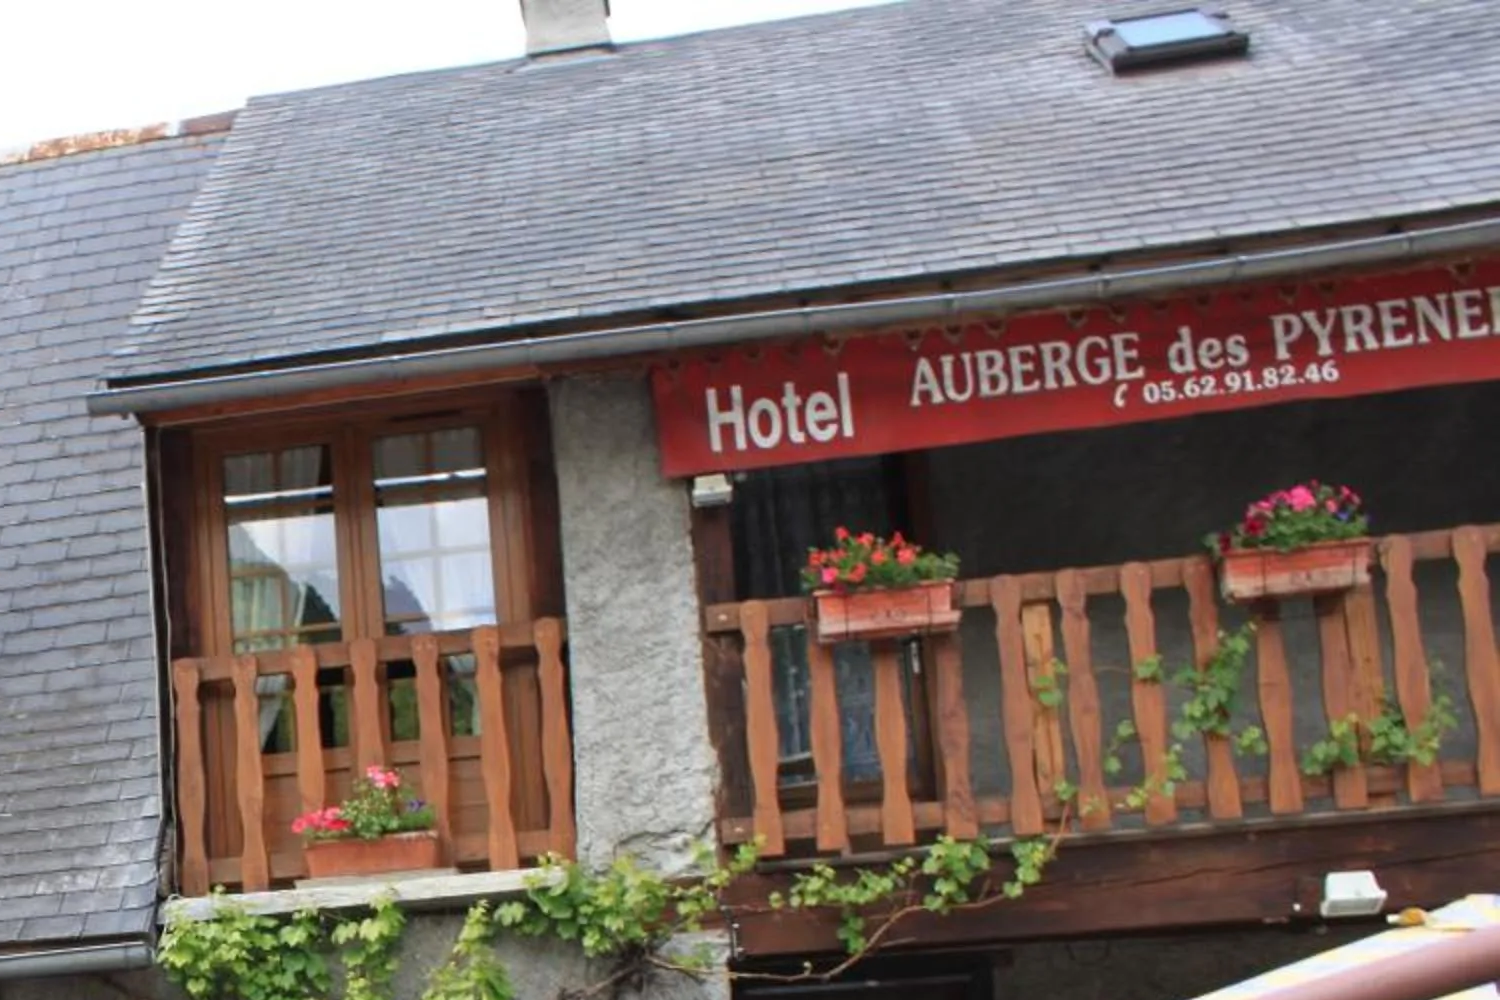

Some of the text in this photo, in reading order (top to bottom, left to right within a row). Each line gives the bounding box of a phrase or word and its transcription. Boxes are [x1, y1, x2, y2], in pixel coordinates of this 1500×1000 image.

[910, 332, 1145, 407] AUBERGE
[1167, 325, 1250, 374] des
[1142, 359, 1341, 404] 05.62.91.82.46
[705, 371, 855, 453] Hotel
